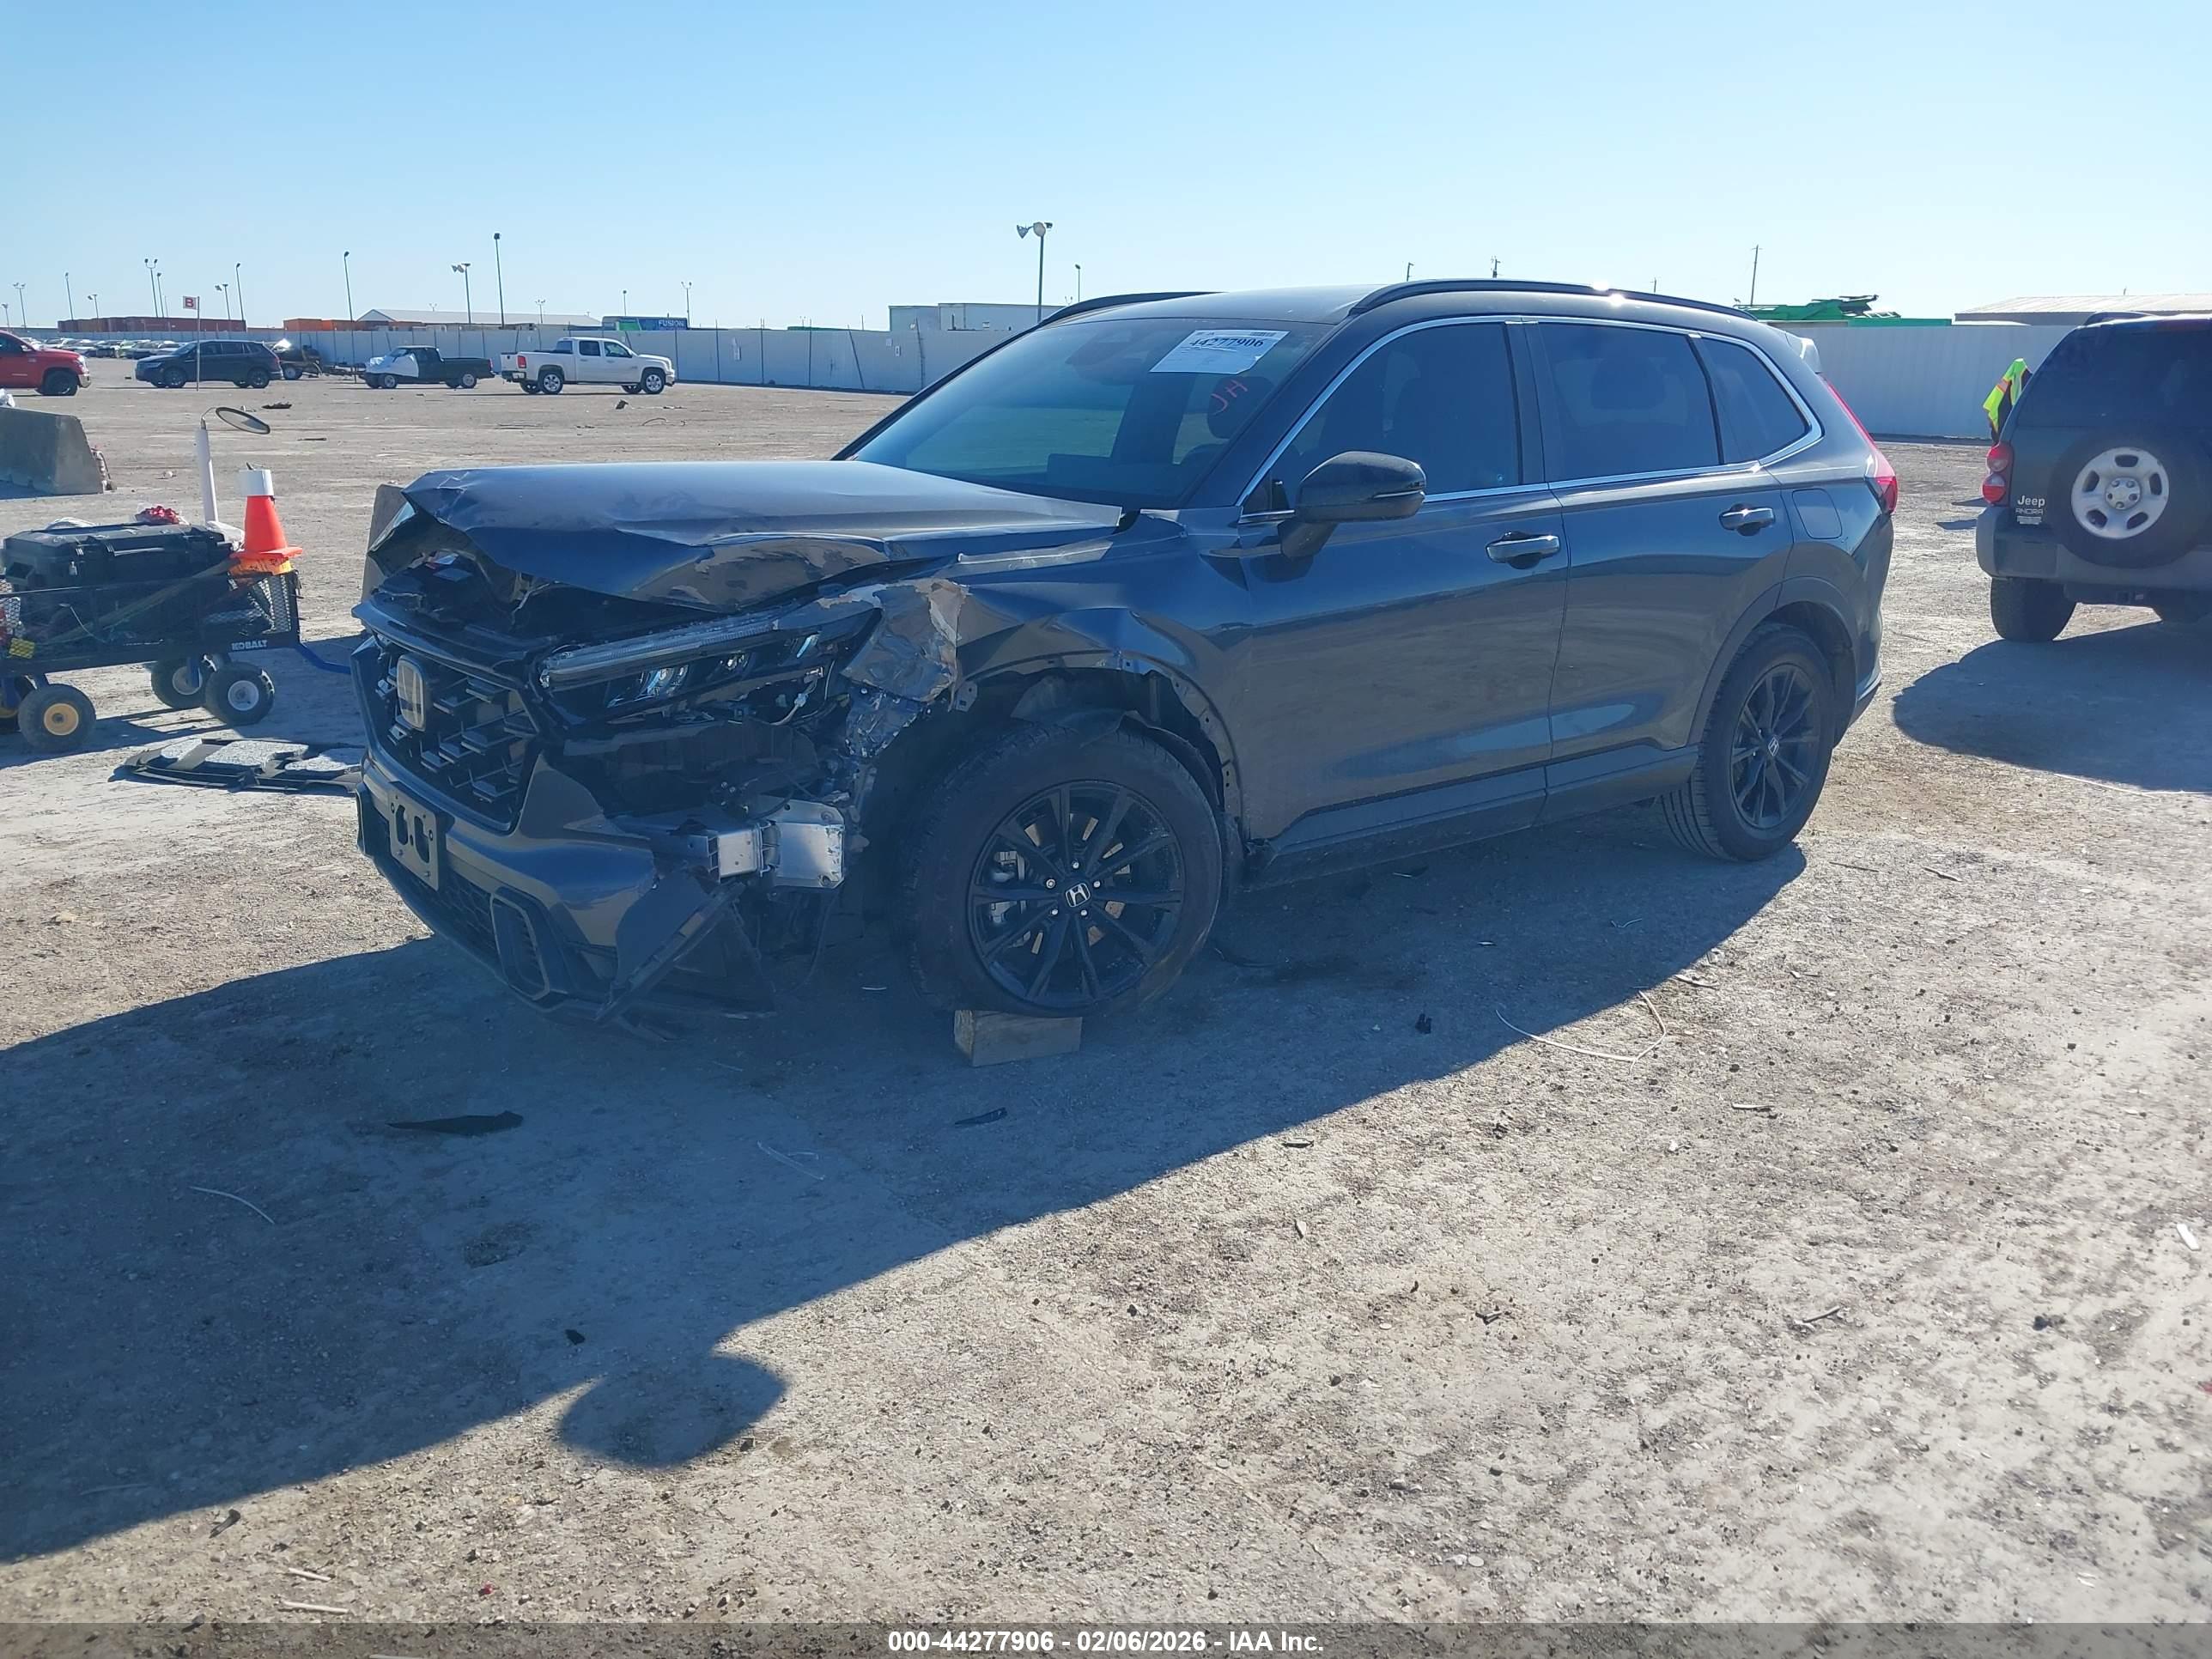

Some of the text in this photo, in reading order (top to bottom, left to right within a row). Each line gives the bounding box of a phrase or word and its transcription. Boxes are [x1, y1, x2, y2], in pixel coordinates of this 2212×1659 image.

[185, 298, 194, 307] B
[1189, 338, 1264, 347] 44277906
[2017, 495, 2045, 508] Jeep
[231, 639, 268, 651] KOBALT
